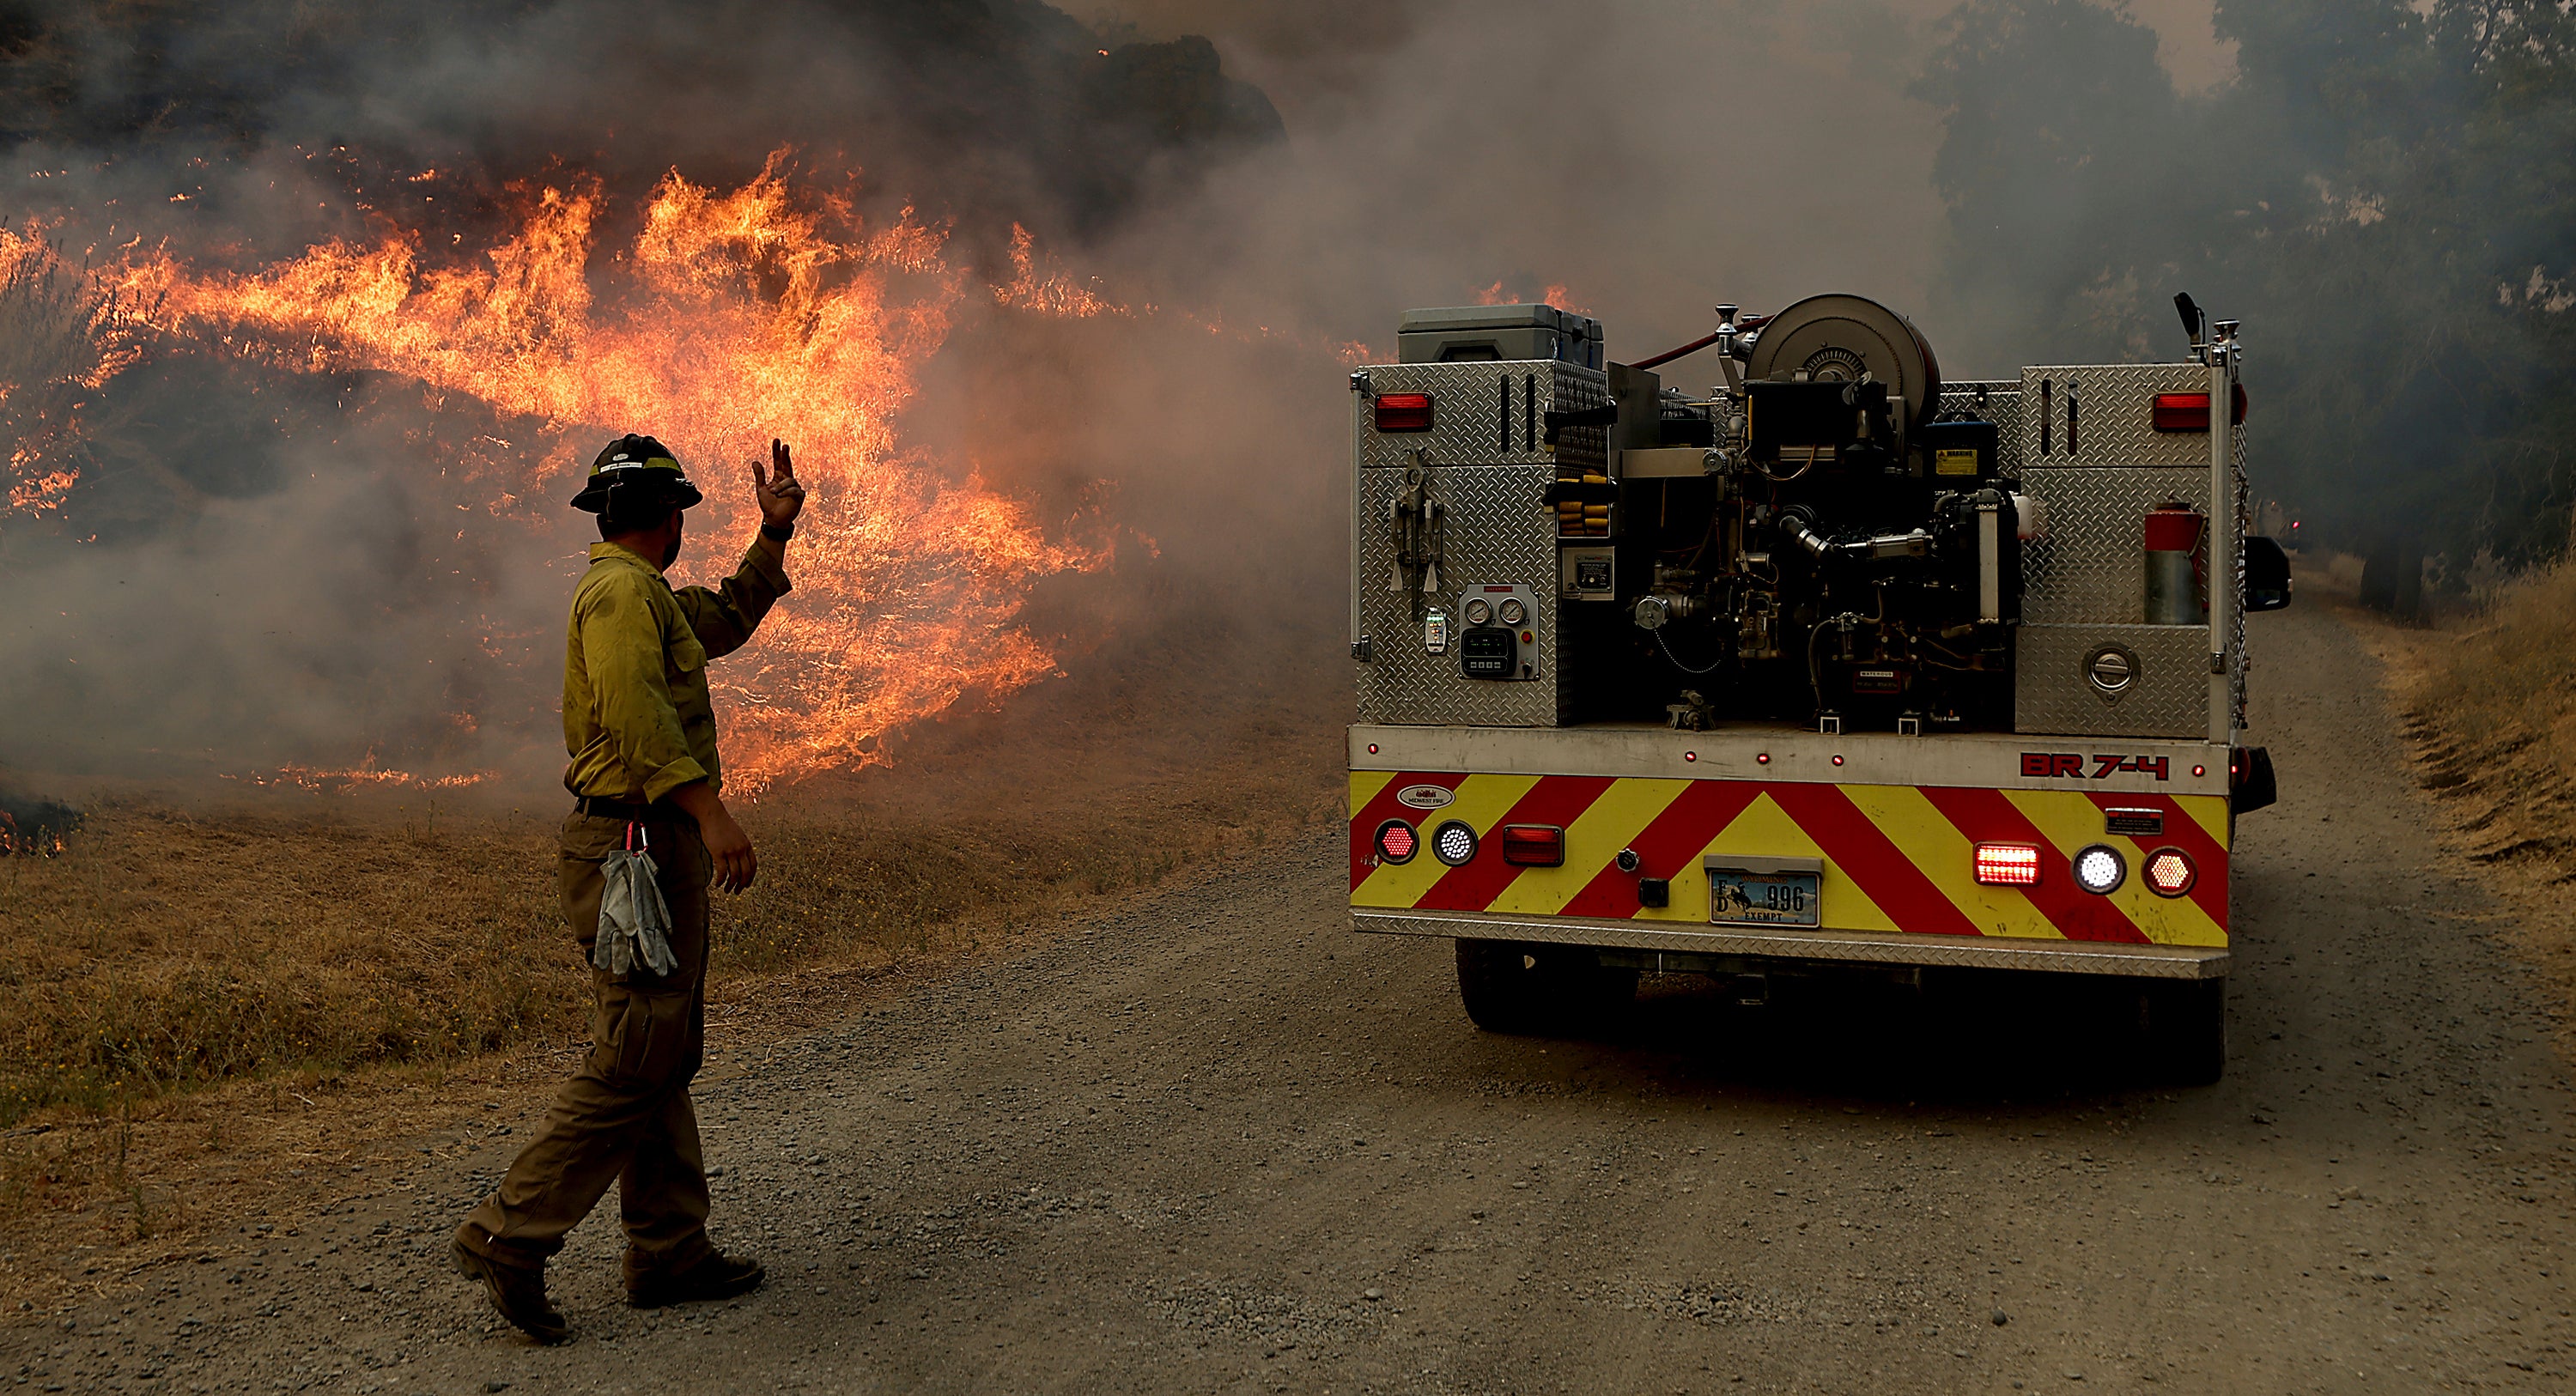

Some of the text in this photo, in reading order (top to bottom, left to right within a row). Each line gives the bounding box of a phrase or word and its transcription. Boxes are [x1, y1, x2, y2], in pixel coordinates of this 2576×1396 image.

[2020, 752, 2169, 781] BR 7-4
[1741, 876, 1788, 884] WYOMING
[1767, 885, 1804, 912] 996
[1745, 912, 1783, 922] EXEMPT
